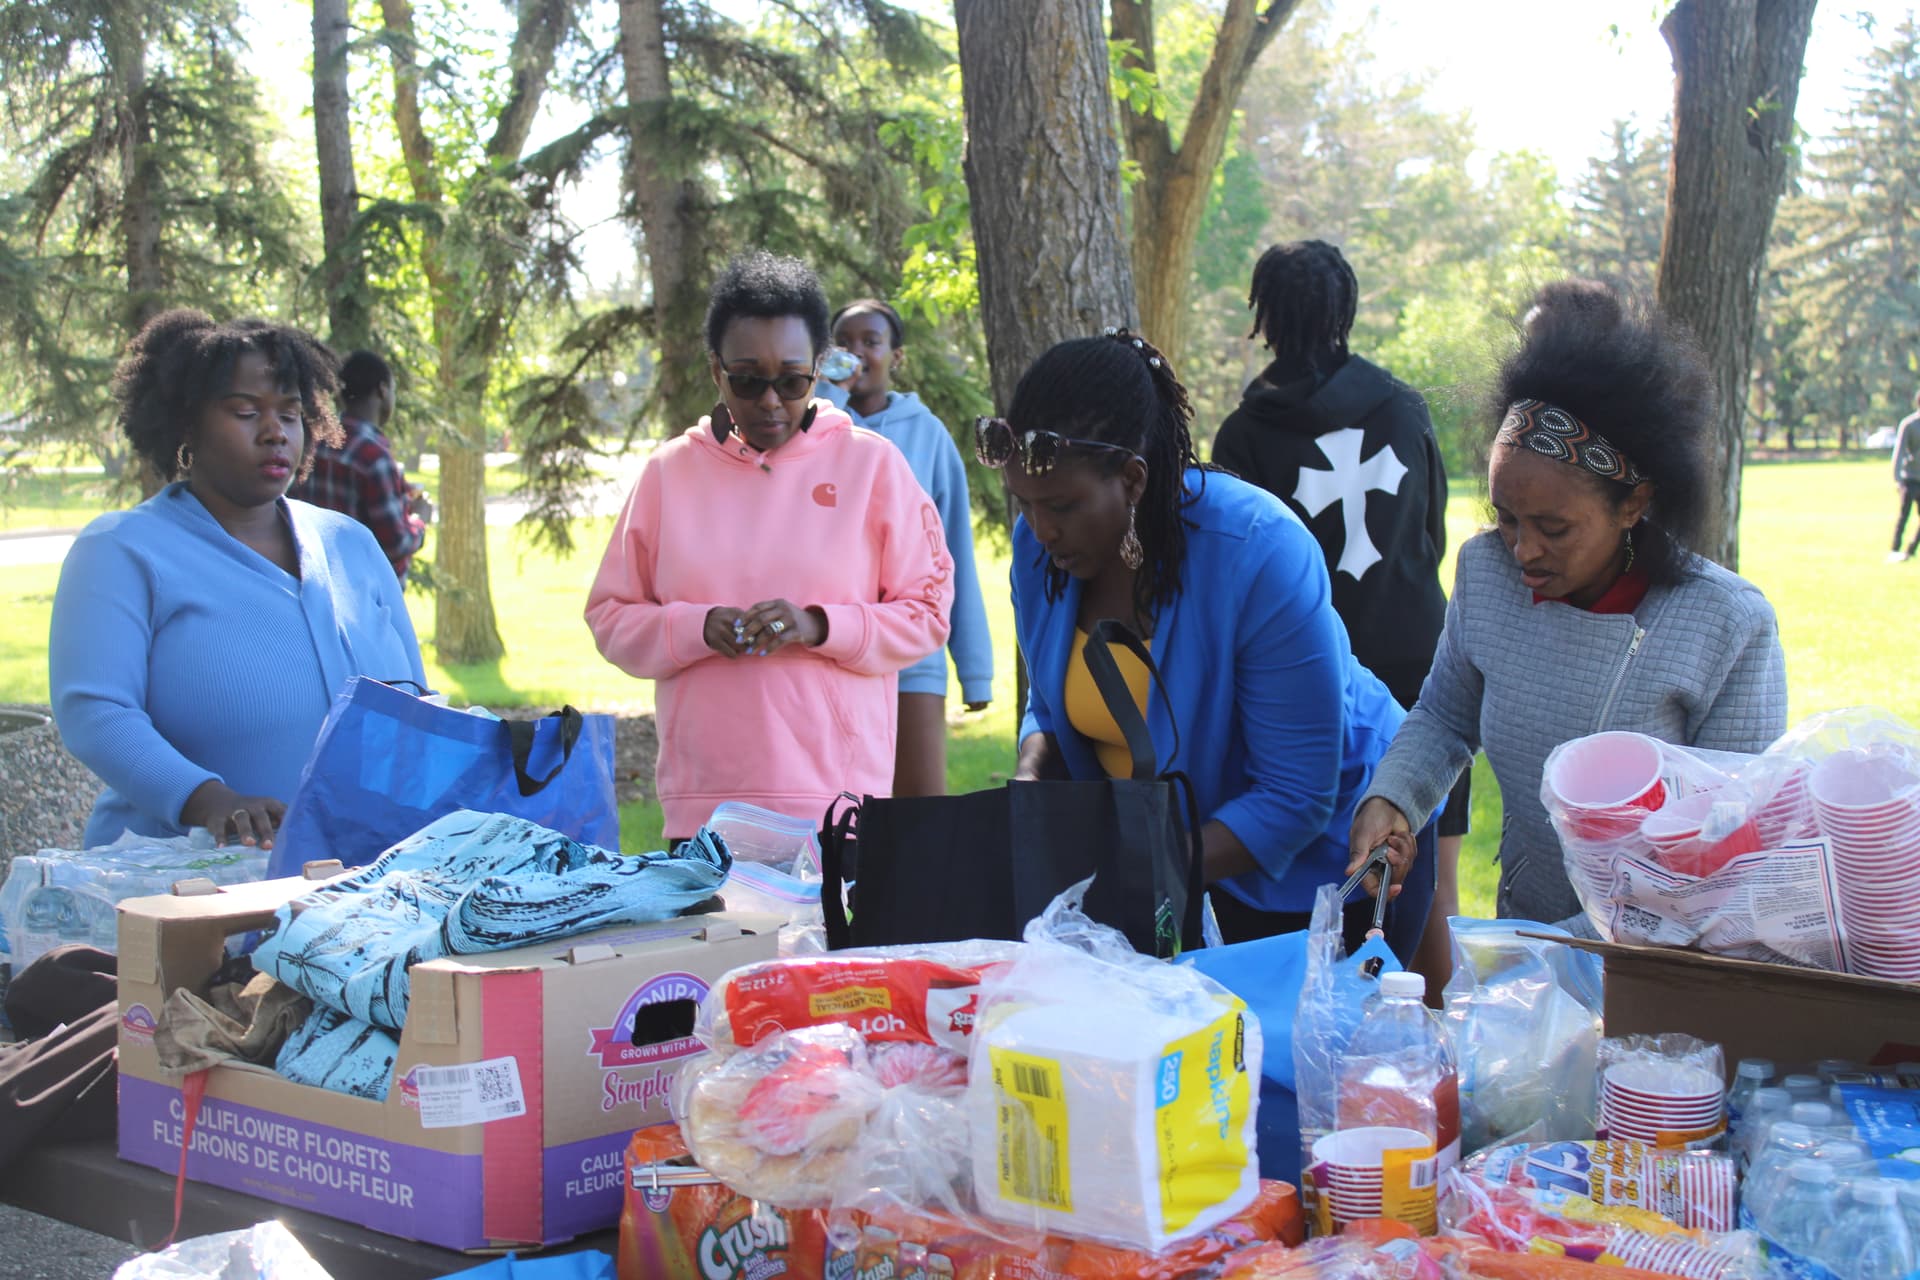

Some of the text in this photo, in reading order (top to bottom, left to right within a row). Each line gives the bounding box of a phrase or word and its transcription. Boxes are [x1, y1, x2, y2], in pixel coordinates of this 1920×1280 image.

[620, 1045, 659, 1060] GROWN
[661, 1041, 687, 1055] WITH
[603, 1069, 674, 1111] Simply
[1161, 1056, 1180, 1101] 250
[1206, 1029, 1231, 1140] napkins
[169, 1098, 392, 1174] CULIFLOWER FLORETS
[1590, 1140, 1608, 1165] Cup
[254, 1147, 281, 1173] DE
[284, 1155, 415, 1209] CHOU-FLEUR
[565, 1169, 625, 1198] FLEURO
[700, 1200, 787, 1280] Crush
